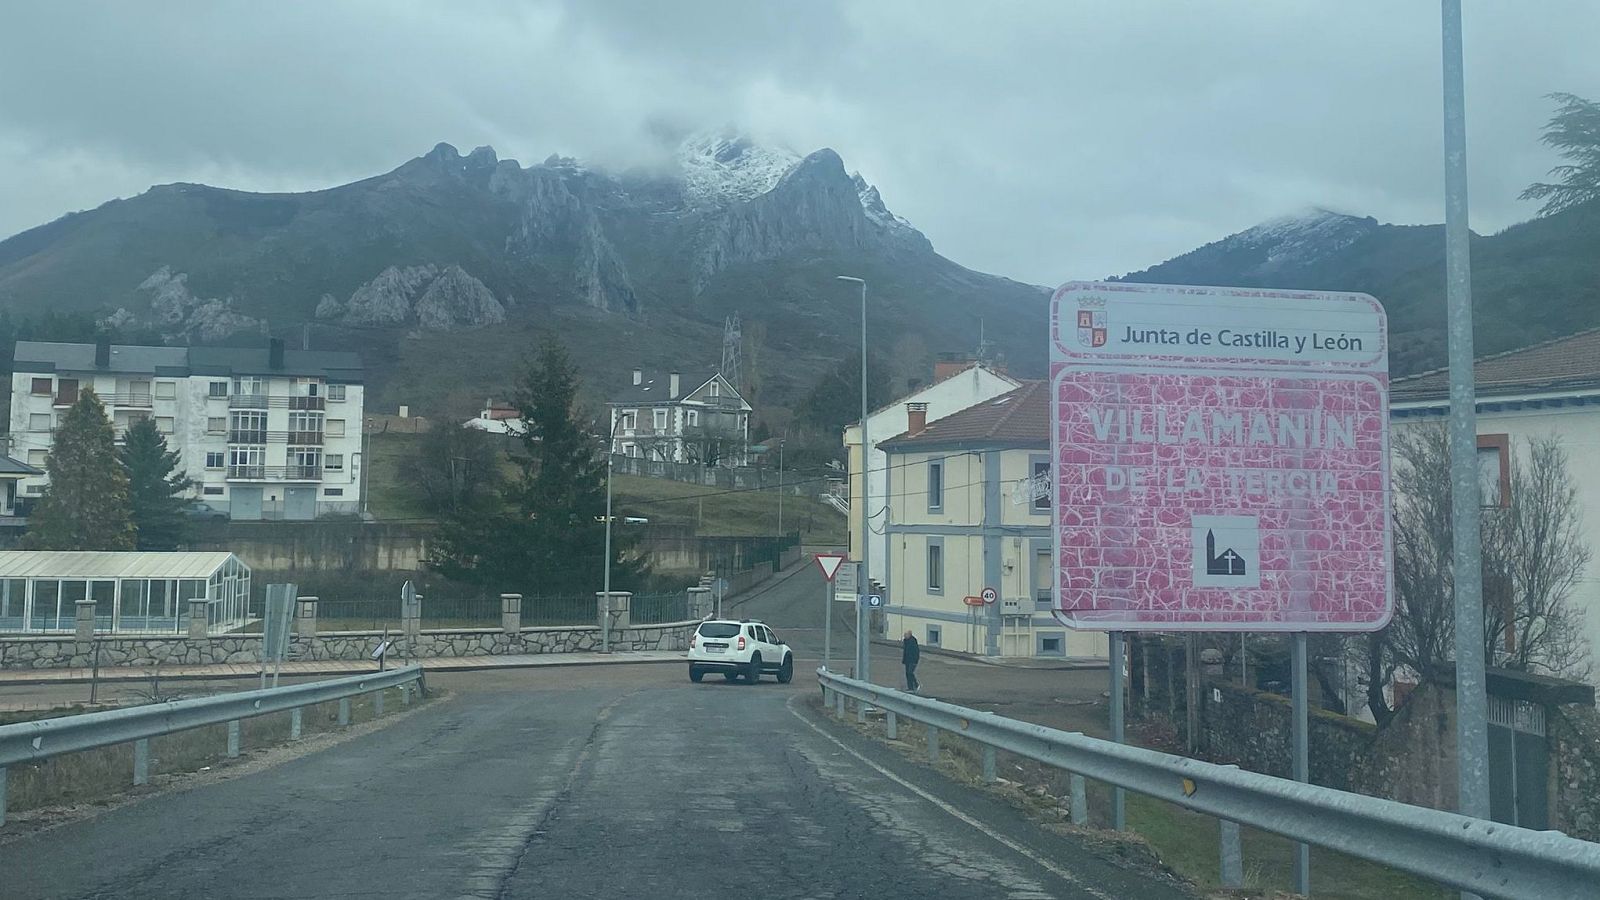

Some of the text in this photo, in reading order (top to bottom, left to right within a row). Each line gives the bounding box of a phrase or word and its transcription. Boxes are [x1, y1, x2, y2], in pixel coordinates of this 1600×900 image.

[1121, 326, 1363, 354] Junta de Castilla y León
[1089, 405, 1357, 449] VILLAMANÍN
[1105, 466, 1339, 497] DE LA TERCIA
